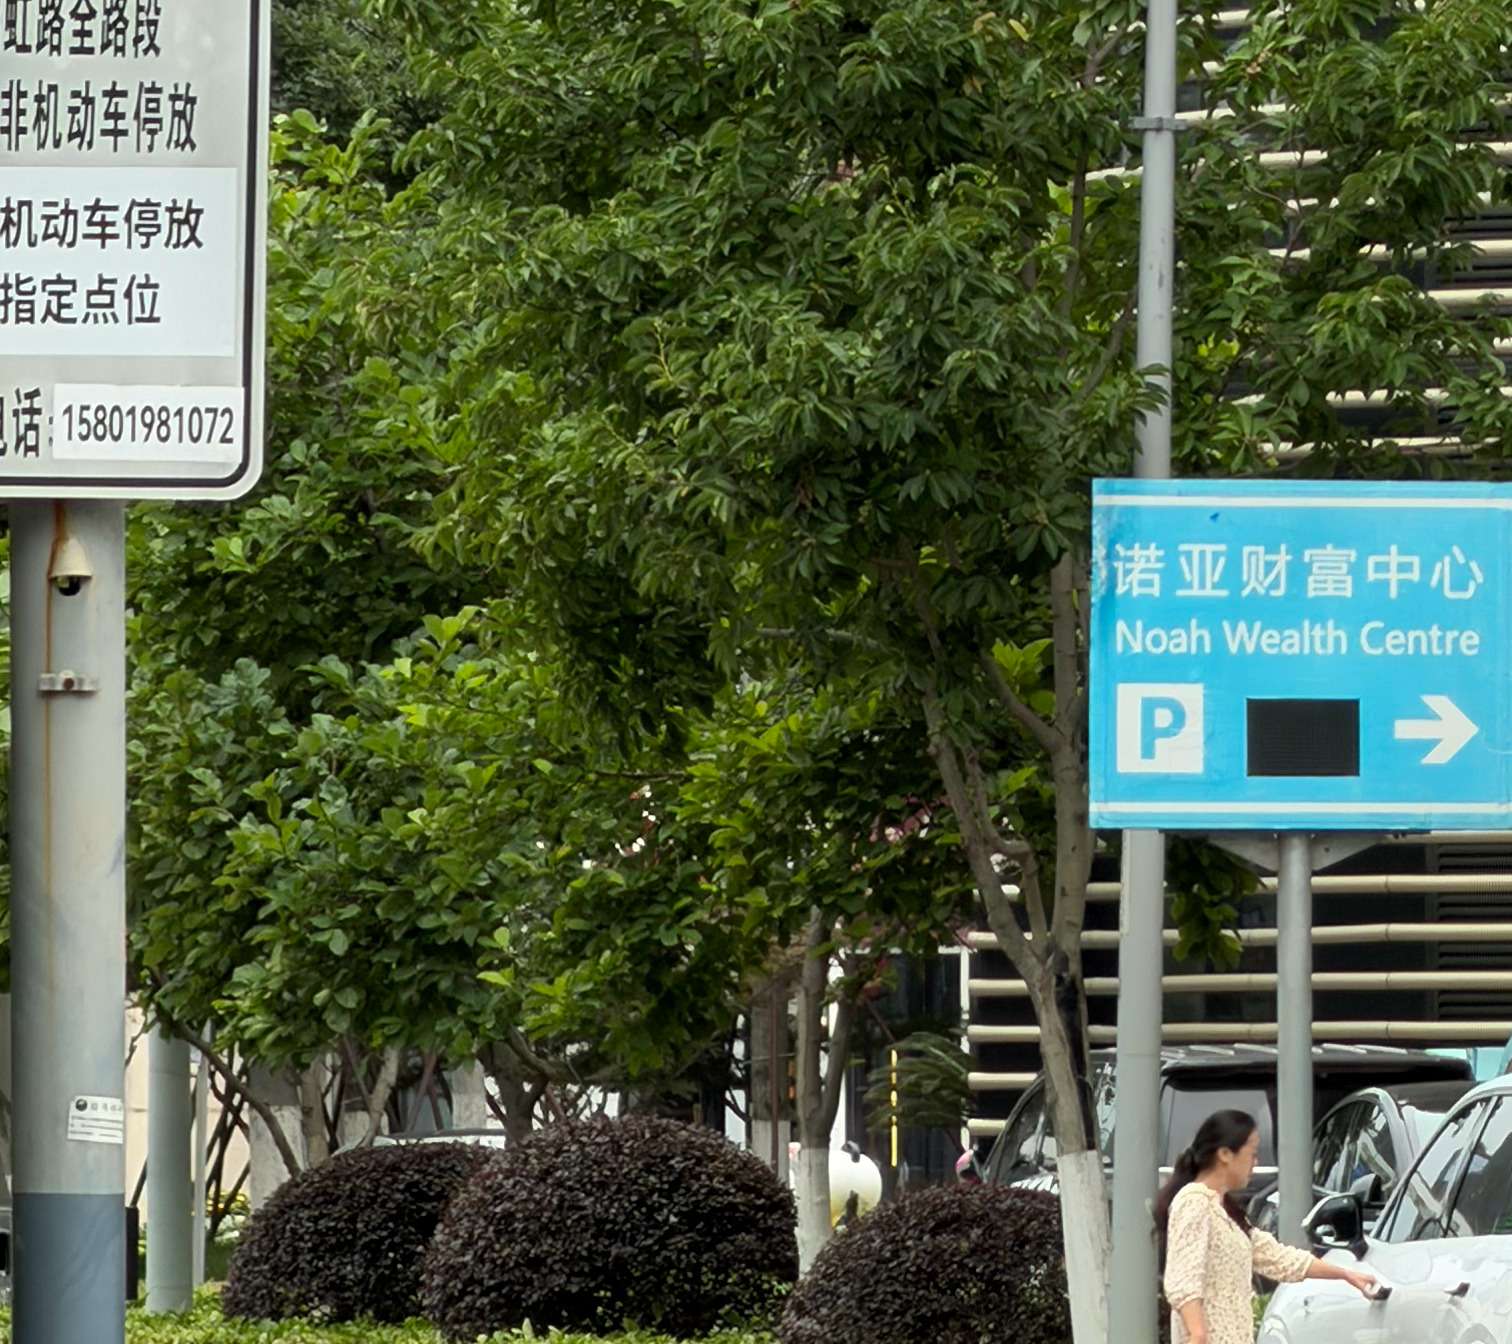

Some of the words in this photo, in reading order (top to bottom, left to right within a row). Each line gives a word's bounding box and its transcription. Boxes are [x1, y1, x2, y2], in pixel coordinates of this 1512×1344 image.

[0, 79, 198, 153] 非机动车停放
[0, 196, 205, 249] 机动车停放
[0, 272, 161, 325] 指定点位
[0, 387, 53, 458] 话:
[62, 404, 234, 445] 15801981072
[1112, 543, 1484, 600] 诺亚财富中心
[1115, 618, 1211, 655] Noah
[1222, 618, 1348, 655] Wealth
[1360, 620, 1480, 655] Centre
[1140, 696, 1187, 760] P
